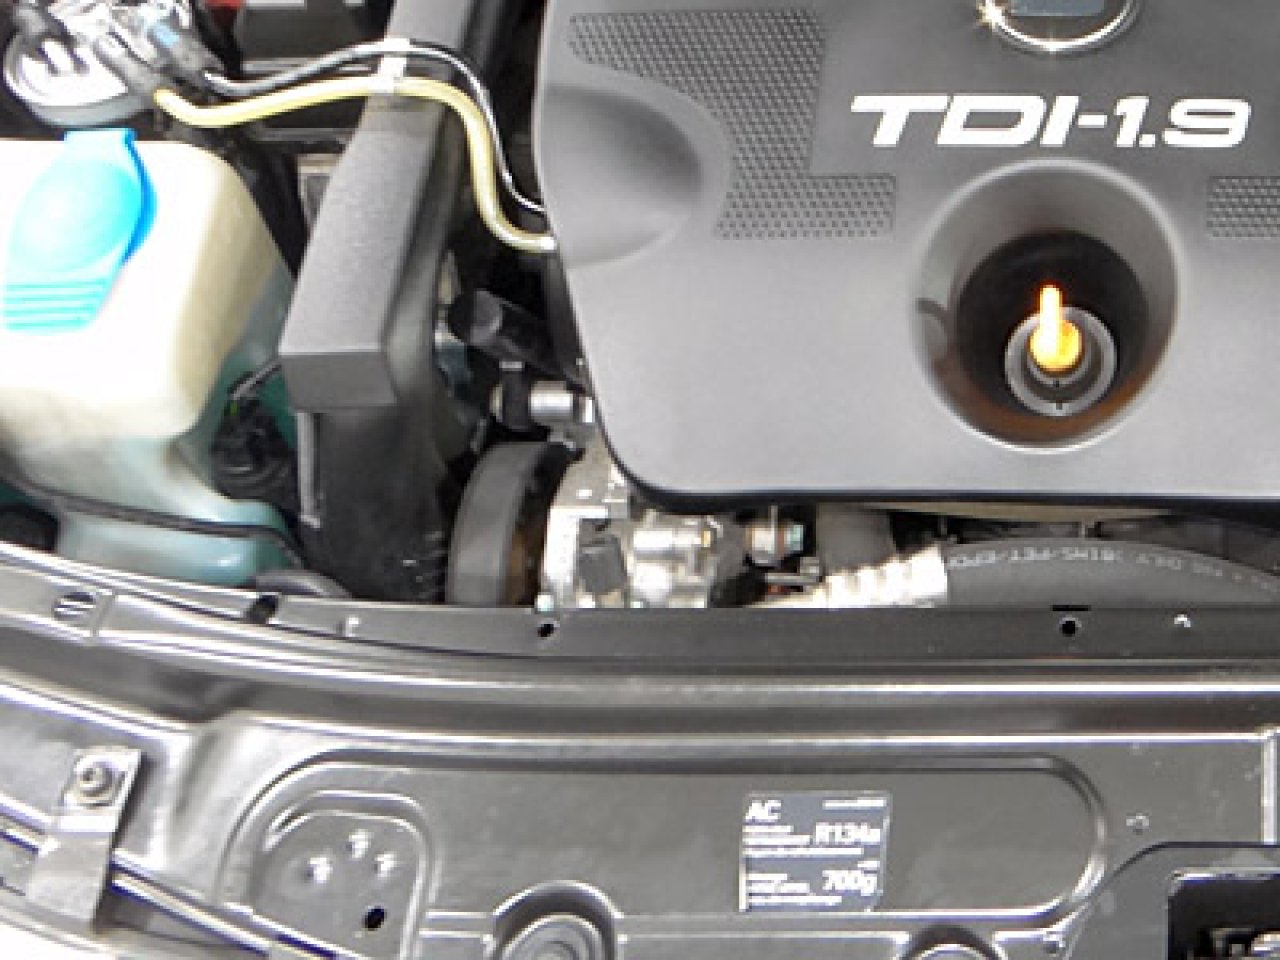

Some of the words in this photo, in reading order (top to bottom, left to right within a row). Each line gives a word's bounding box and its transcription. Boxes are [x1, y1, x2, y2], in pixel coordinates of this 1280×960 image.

[850, 94, 1253, 148] TDI-1.9
[745, 799, 782, 822] AC
[822, 869, 878, 897] 700g
